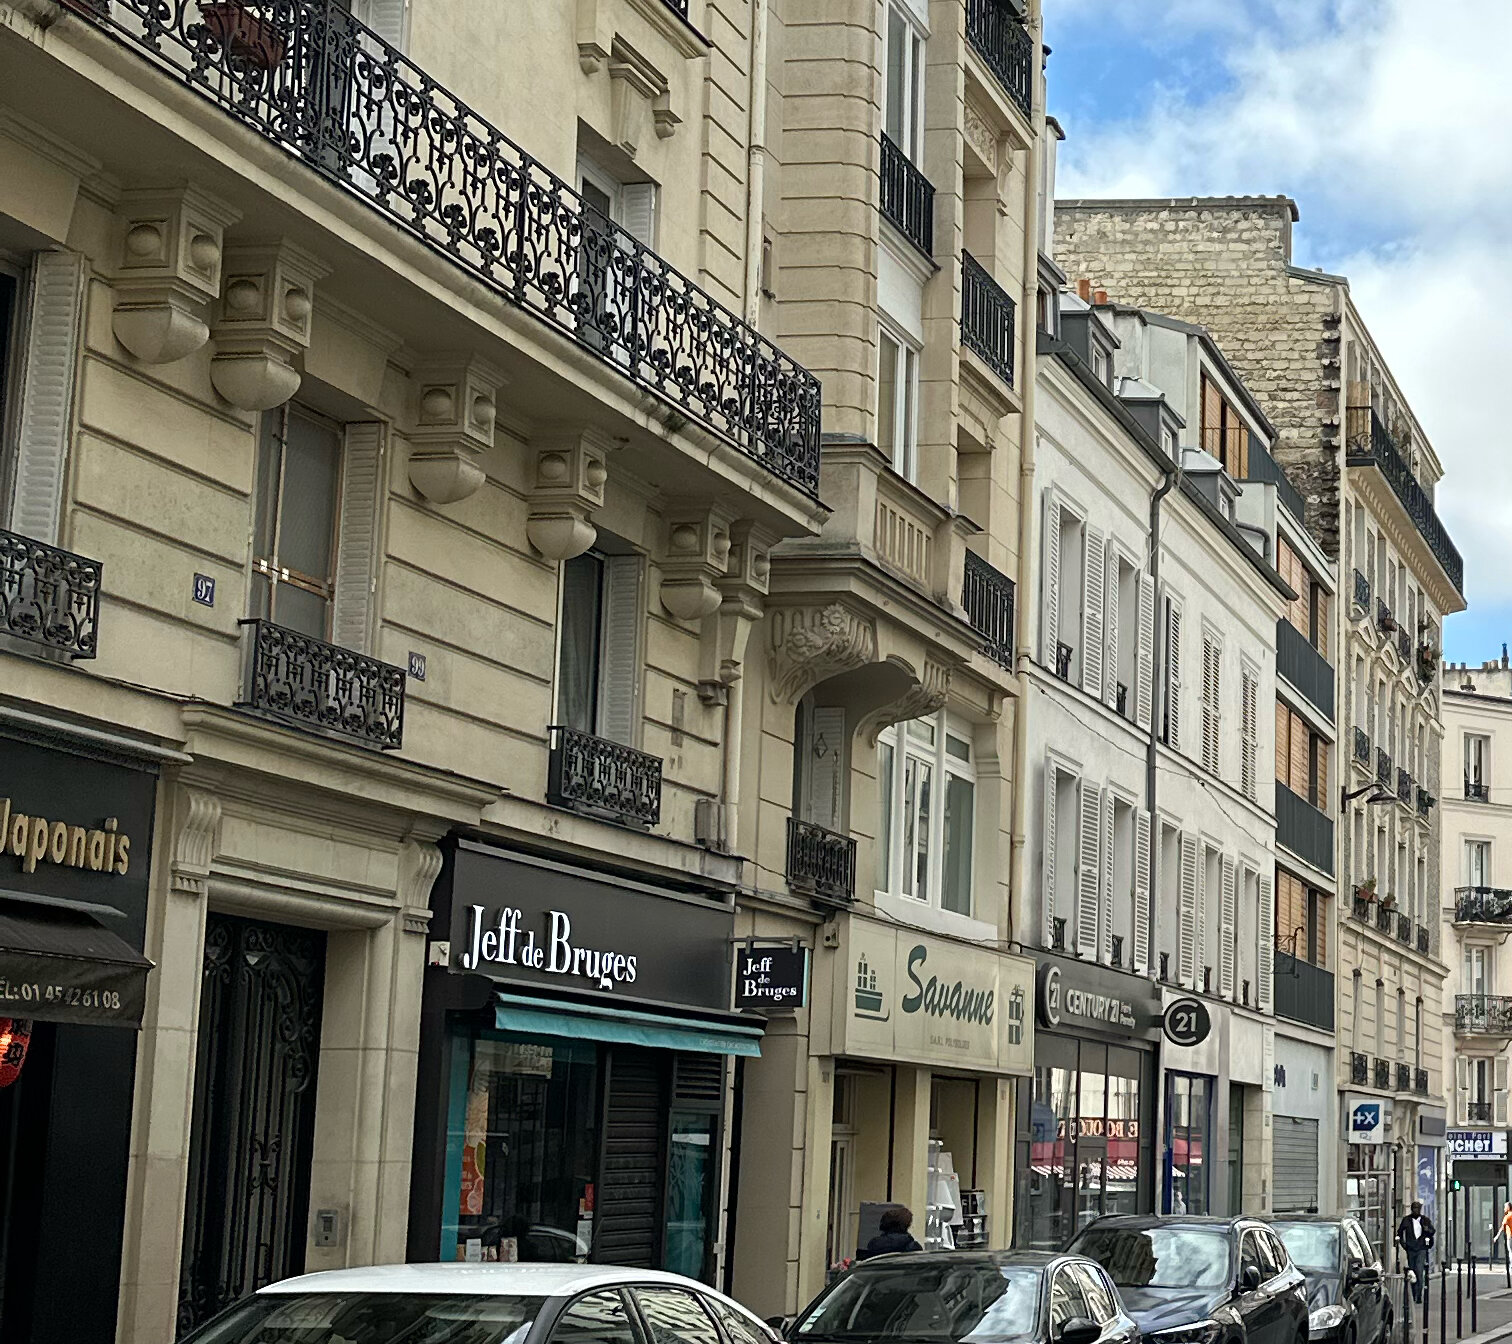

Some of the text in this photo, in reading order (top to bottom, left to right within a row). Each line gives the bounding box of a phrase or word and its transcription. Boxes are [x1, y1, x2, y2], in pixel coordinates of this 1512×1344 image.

[196, 578, 213, 604] 97
[411, 655, 425, 678] 99
[0, 798, 131, 875] Japonais
[463, 905, 638, 990] Jeff de Bruges
[743, 958, 773, 976] Jeff
[757, 975, 771, 985] de
[21, 983, 40, 1002] 01
[102, 992, 121, 1010] 08
[743, 978, 798, 1001] Bruges
[901, 944, 995, 1026] Savanne
[1066, 988, 1110, 1022] CENTURY
[1109, 999, 1120, 1024] 21
